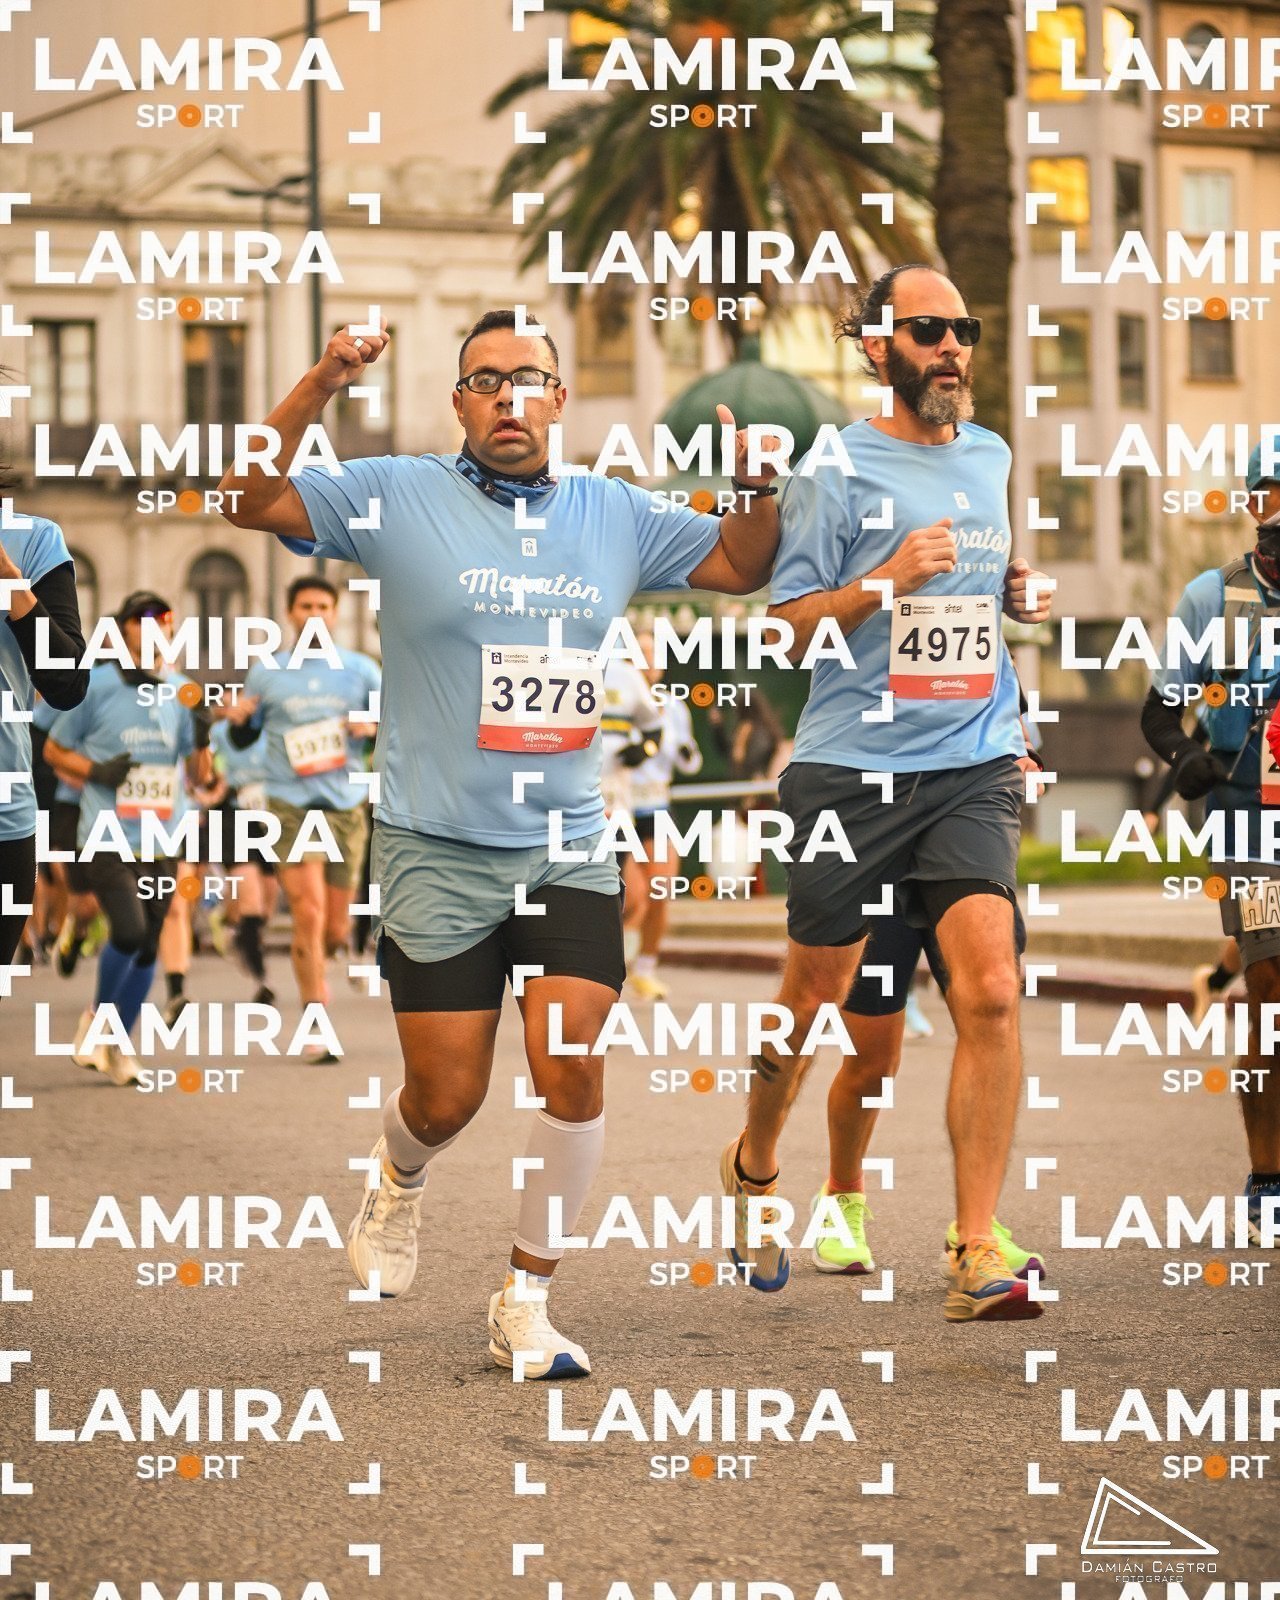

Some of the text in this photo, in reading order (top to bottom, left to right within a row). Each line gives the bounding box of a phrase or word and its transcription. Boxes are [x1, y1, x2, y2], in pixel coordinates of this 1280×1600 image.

[897, 626, 991, 662] 4975
[491, 675, 596, 715] 3278
[521, 731, 564, 744] Maratón
[1242, 885, 1280, 928] MA
